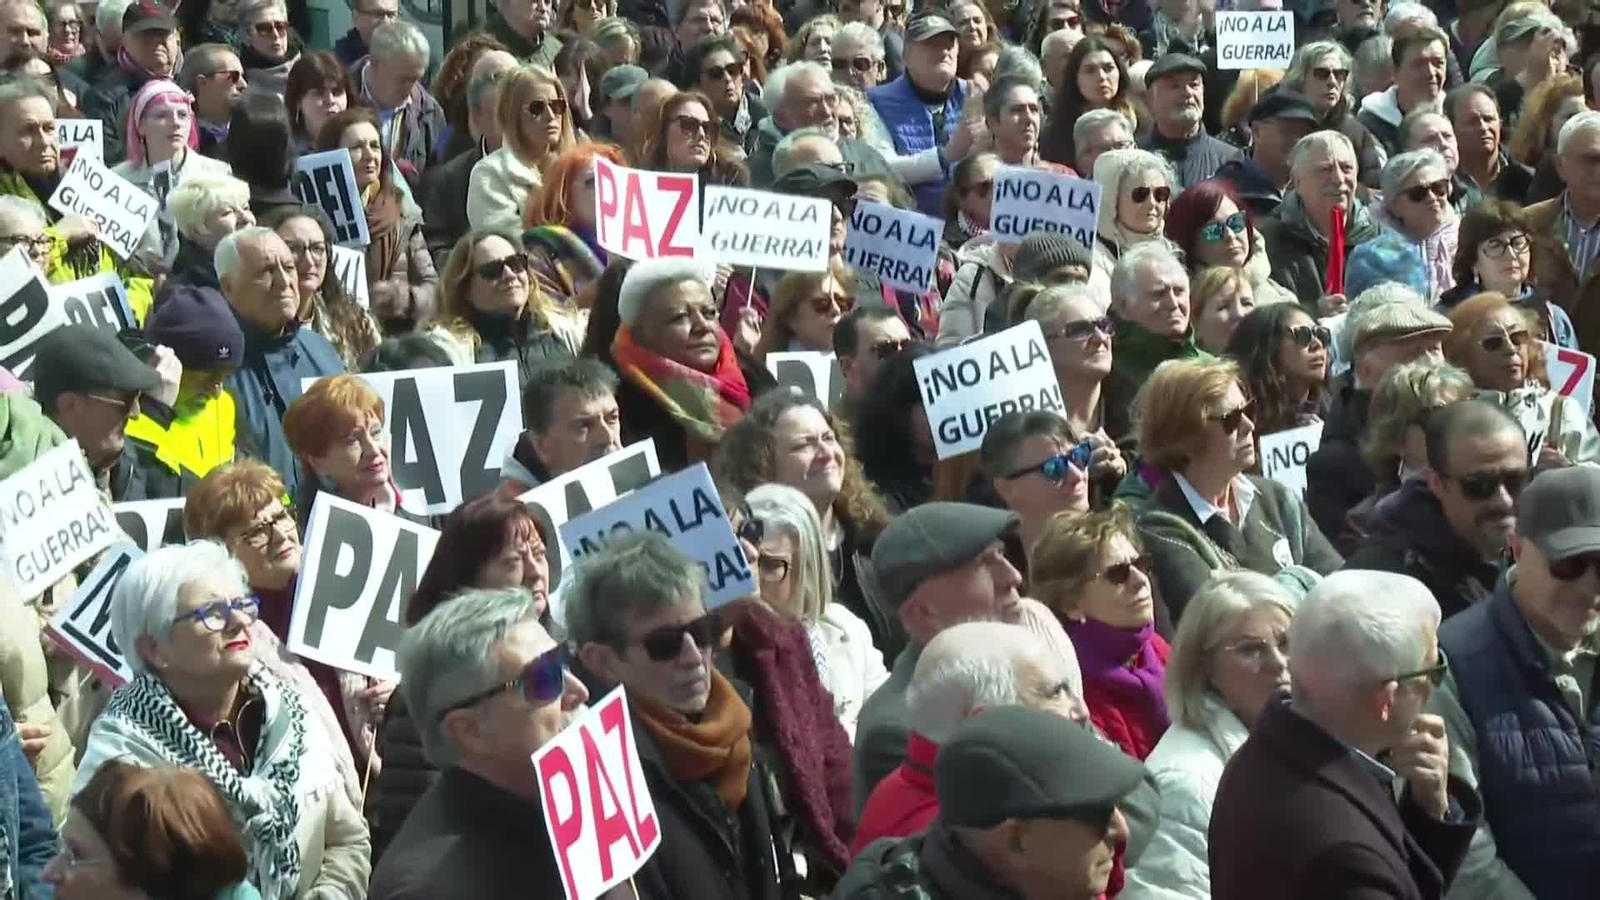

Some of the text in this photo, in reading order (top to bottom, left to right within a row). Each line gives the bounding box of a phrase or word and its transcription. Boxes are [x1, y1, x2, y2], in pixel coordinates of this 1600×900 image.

[1219, 15, 1287, 36] ¡NO A LA
[1222, 43, 1291, 60] GUERRA!
[73, 124, 95, 143] LA
[71, 157, 103, 191] ¡NO
[103, 184, 121, 204] A
[124, 194, 148, 223] LA
[597, 159, 694, 259] PAZ
[996, 178, 1095, 214] ¡NO A LA
[708, 195, 818, 224] ¡NO A LA
[711, 230, 823, 259] GUERRA!
[884, 219, 902, 242] A
[907, 223, 935, 252] LA
[923, 338, 1047, 405] ¡NO A LA
[1266, 441, 1310, 479] ¡NO
[39, 479, 56, 508] A
[55, 459, 87, 495] LA
[669, 486, 721, 534] LA
[16, 505, 110, 583] GUERRA!
[539, 697, 658, 900] PAZ
